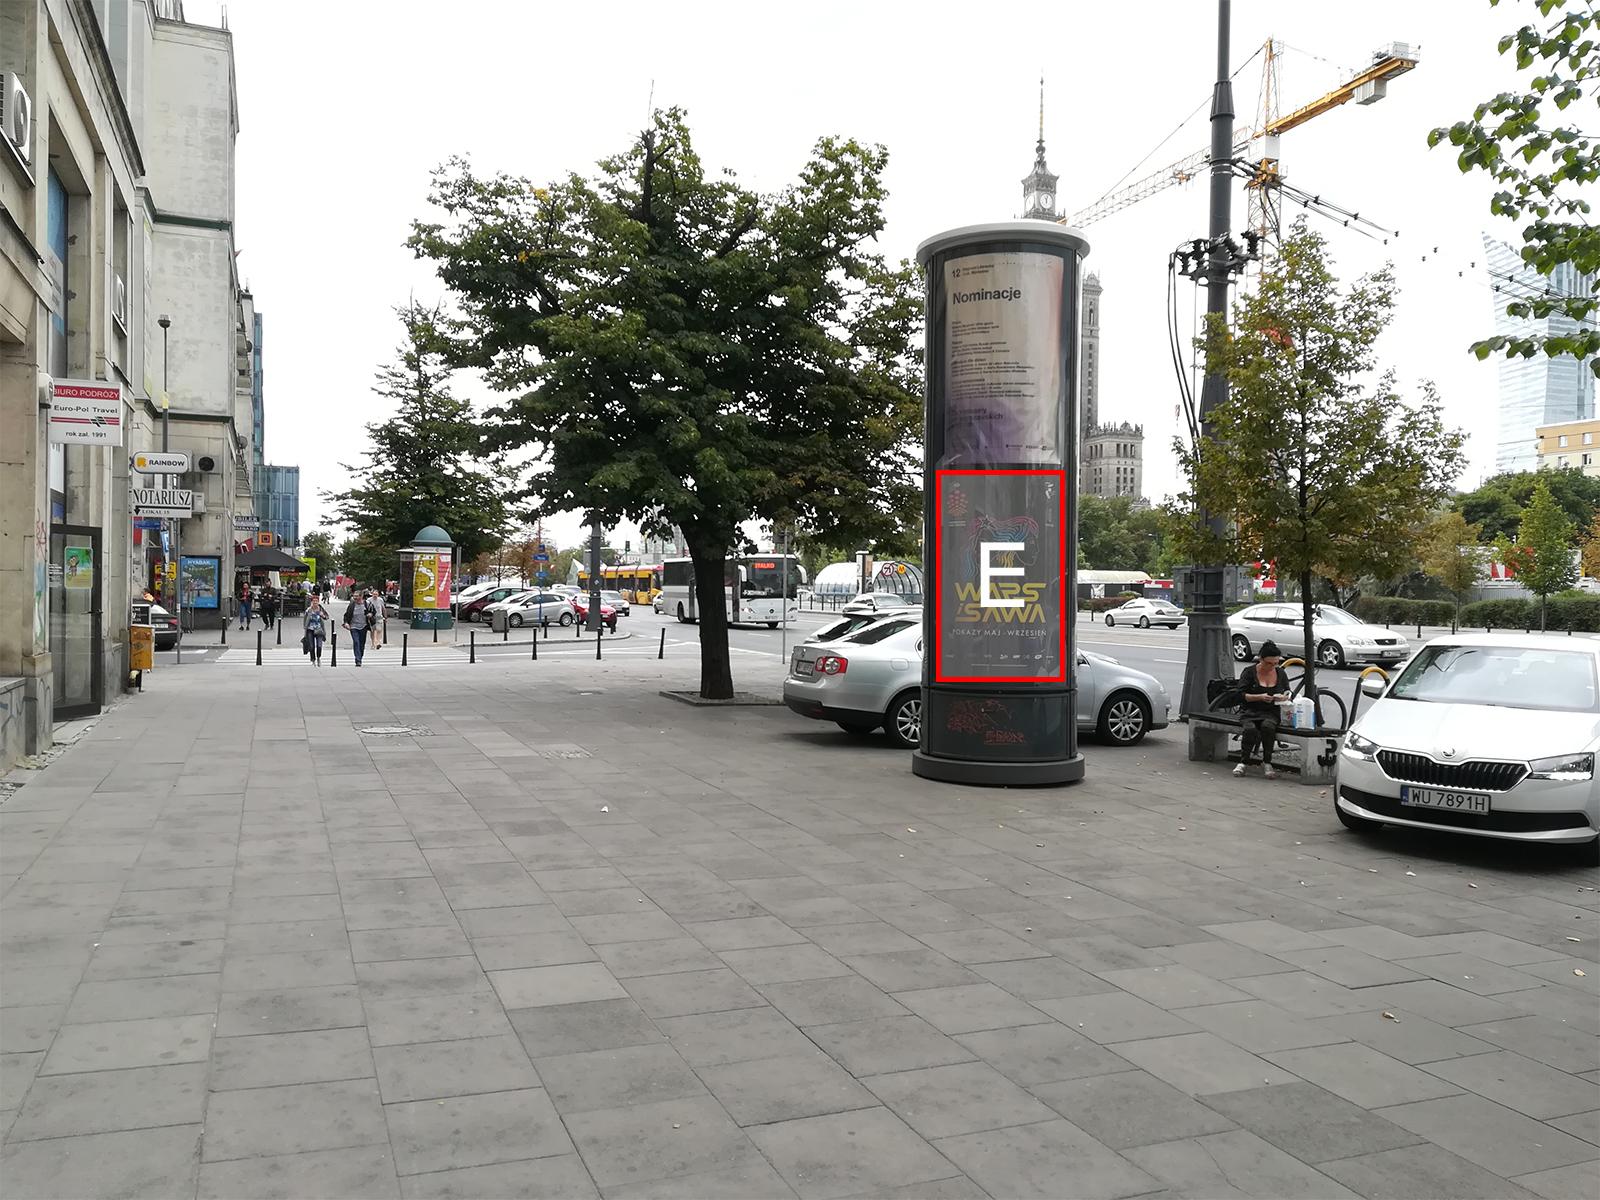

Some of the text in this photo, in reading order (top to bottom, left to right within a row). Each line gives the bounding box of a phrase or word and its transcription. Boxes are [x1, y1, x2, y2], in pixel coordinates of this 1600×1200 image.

[952, 268, 961, 278] 12
[952, 286, 1021, 305] Nominacje
[54, 388, 119, 398] BIURO PODRÓŻY
[133, 489, 191, 505] NOTARIUSZ
[955, 582, 1046, 601] WARS
[1412, 789, 1485, 811] WU 7891H
